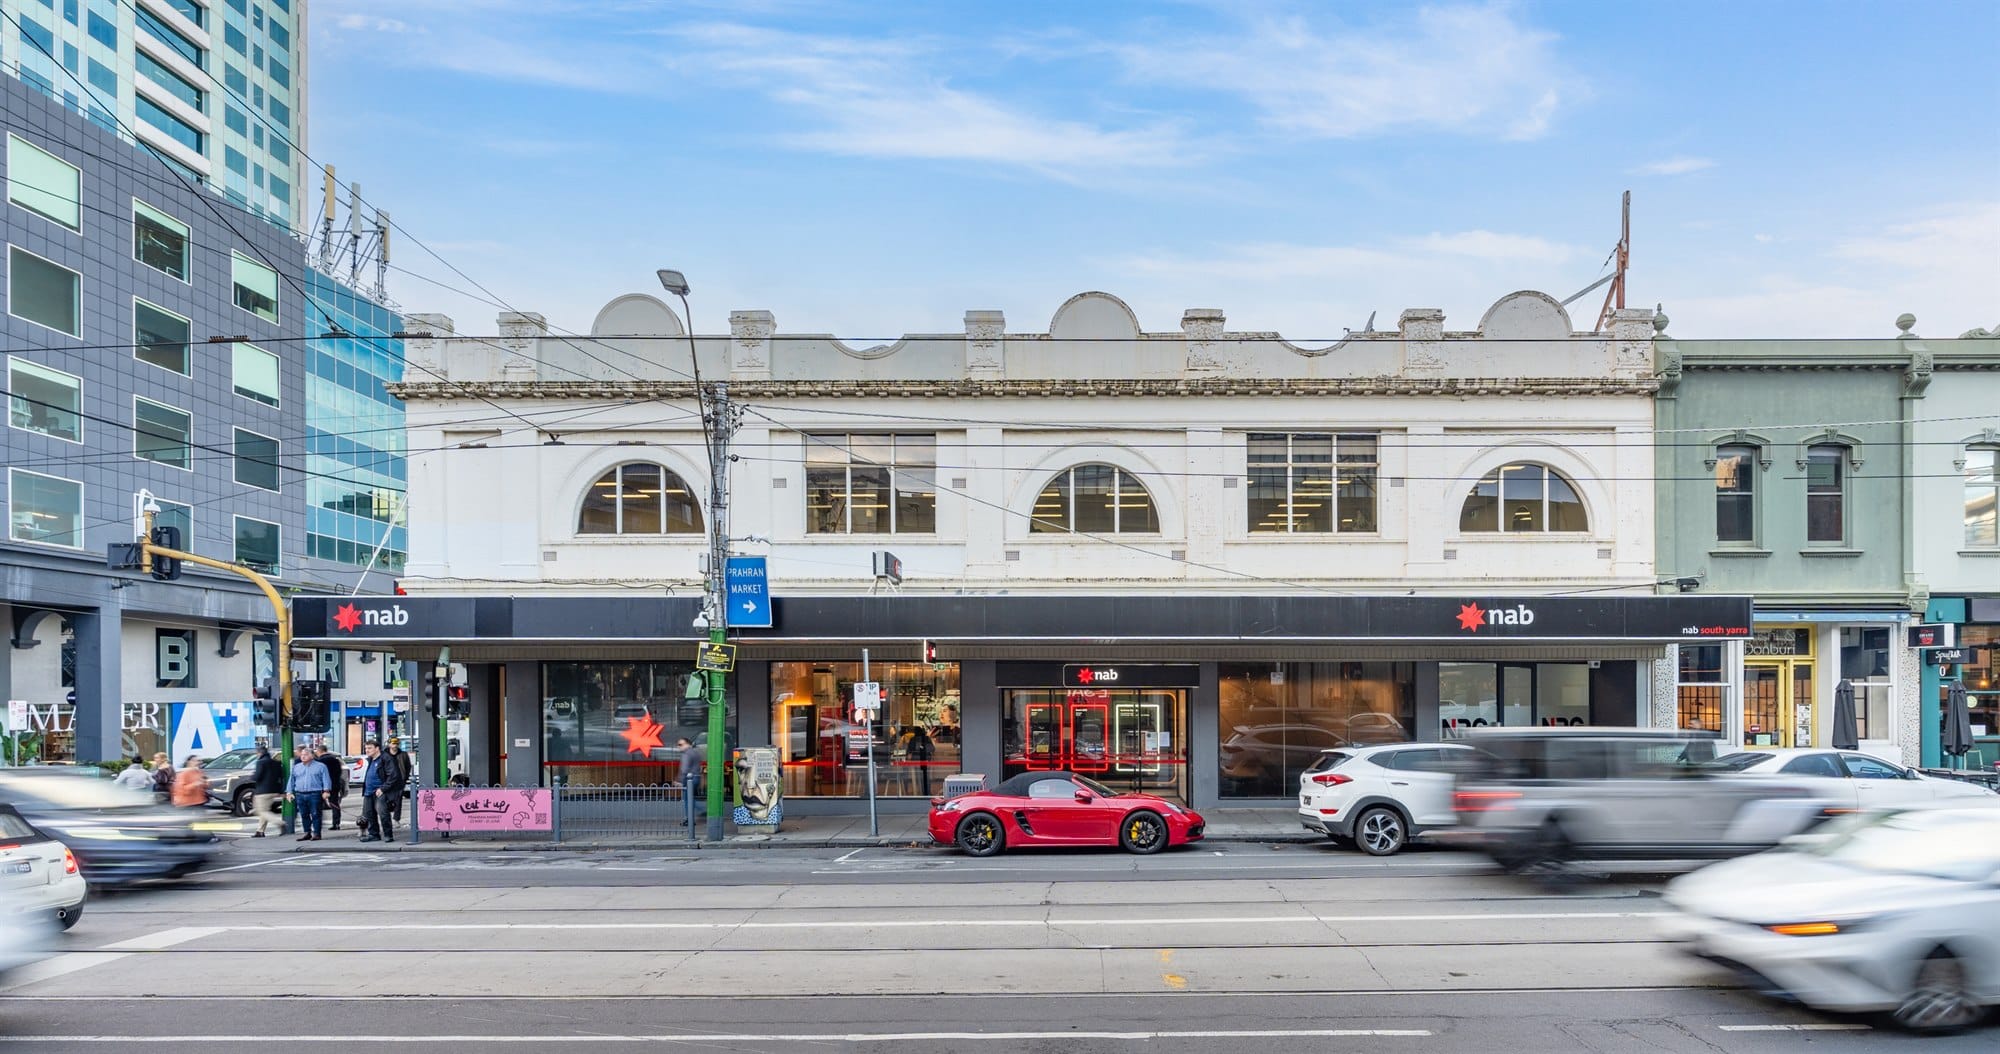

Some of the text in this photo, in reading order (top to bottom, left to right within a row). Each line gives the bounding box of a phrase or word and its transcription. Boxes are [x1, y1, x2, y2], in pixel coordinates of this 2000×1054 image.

[728, 568, 764, 577] PRAHRAN
[731, 584, 762, 594] MARKET
[364, 604, 409, 625] nab
[1488, 604, 1534, 625] nab
[1682, 625, 1748, 636] nab south yarra
[1744, 642, 1796, 656] Donburi
[1094, 669, 1118, 680] nab
[555, 701, 570, 709] nab
[465, 799, 505, 810] eat it up
